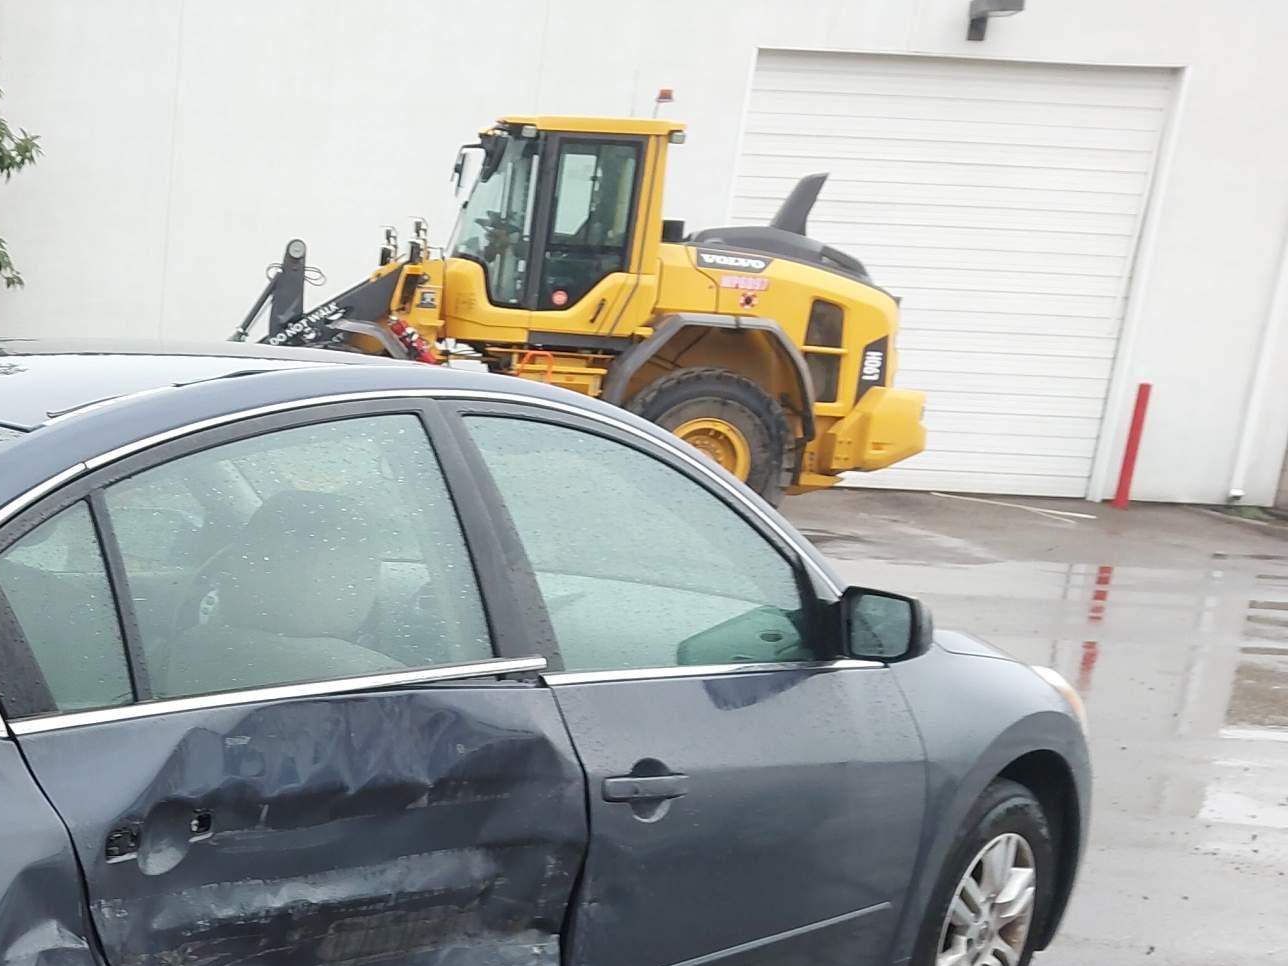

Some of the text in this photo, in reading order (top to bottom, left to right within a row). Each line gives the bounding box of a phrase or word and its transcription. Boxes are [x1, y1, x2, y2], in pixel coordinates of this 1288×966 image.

[700, 253, 766, 269] VOLVO
[269, 332, 287, 346] DO
[308, 301, 339, 322] WALK
[862, 351, 883, 380] L90H
